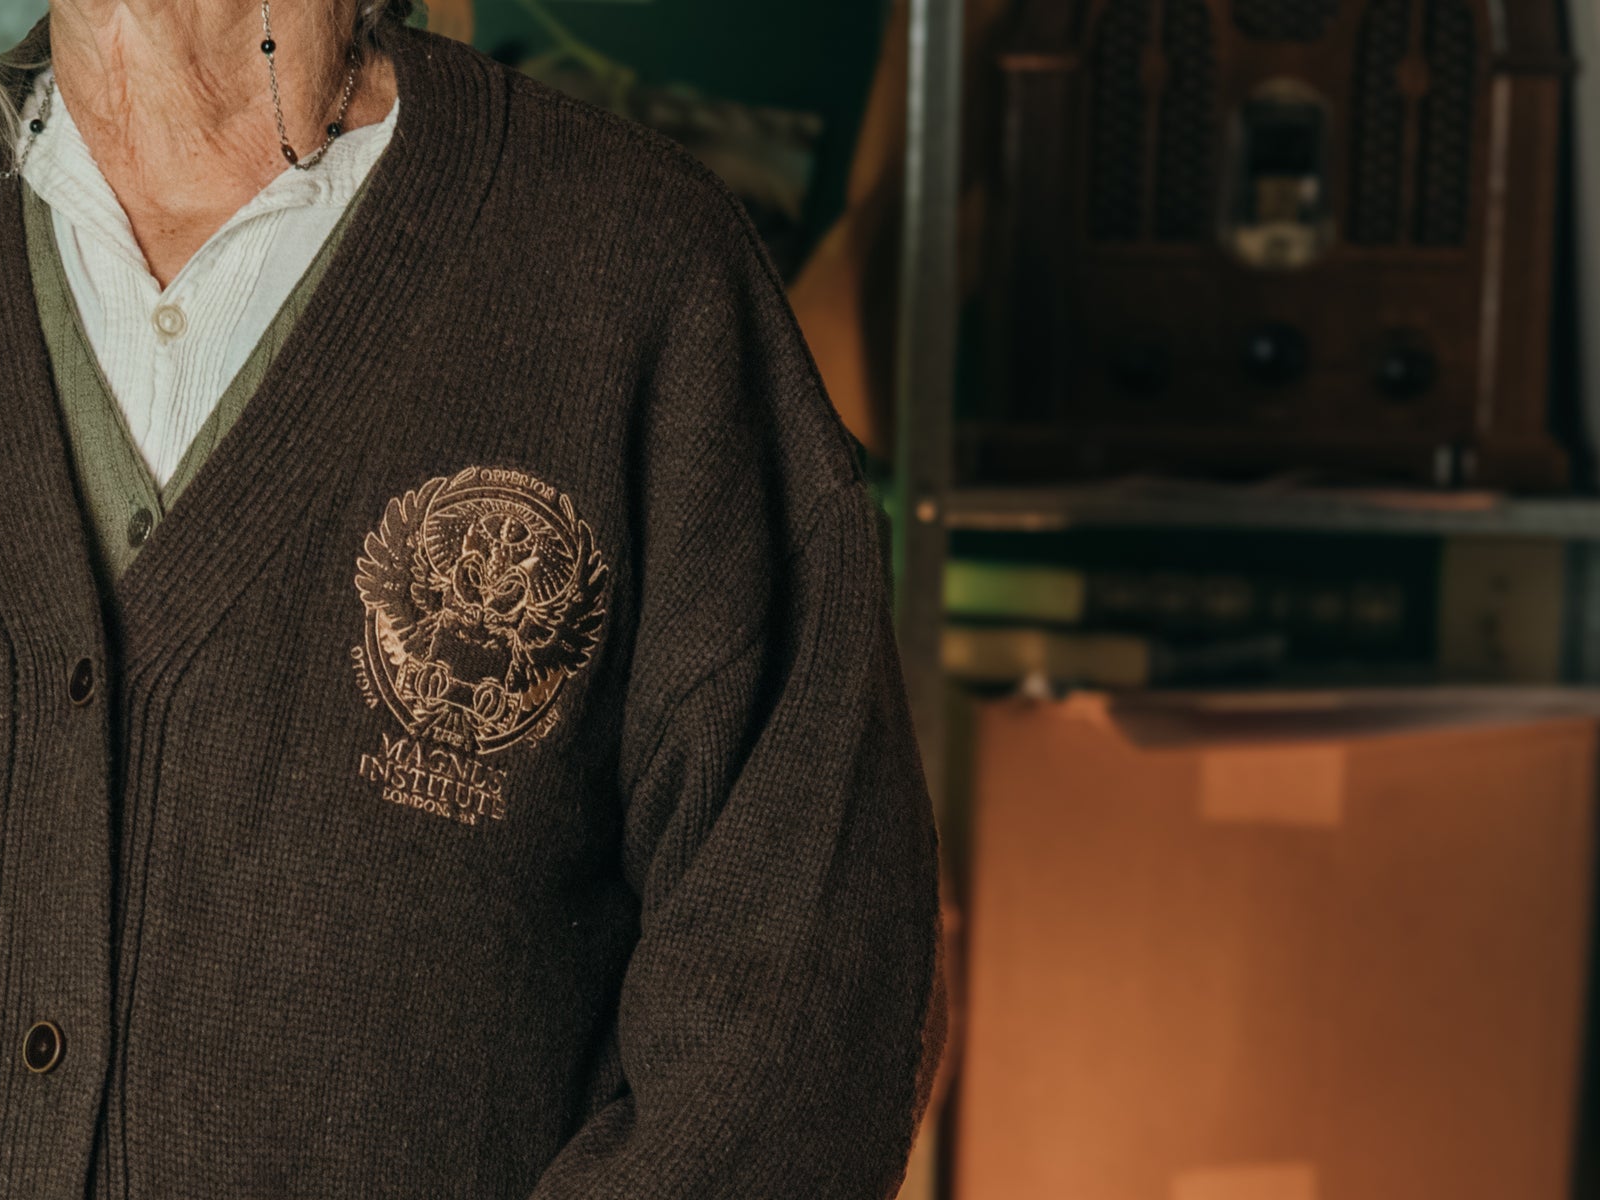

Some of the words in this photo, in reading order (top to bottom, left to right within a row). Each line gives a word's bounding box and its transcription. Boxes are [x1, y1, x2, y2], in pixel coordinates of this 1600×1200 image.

[480, 468, 556, 501] OPPERIOR
[359, 753, 505, 820] INSTITUTE
[382, 732, 507, 794] MAGNUS
